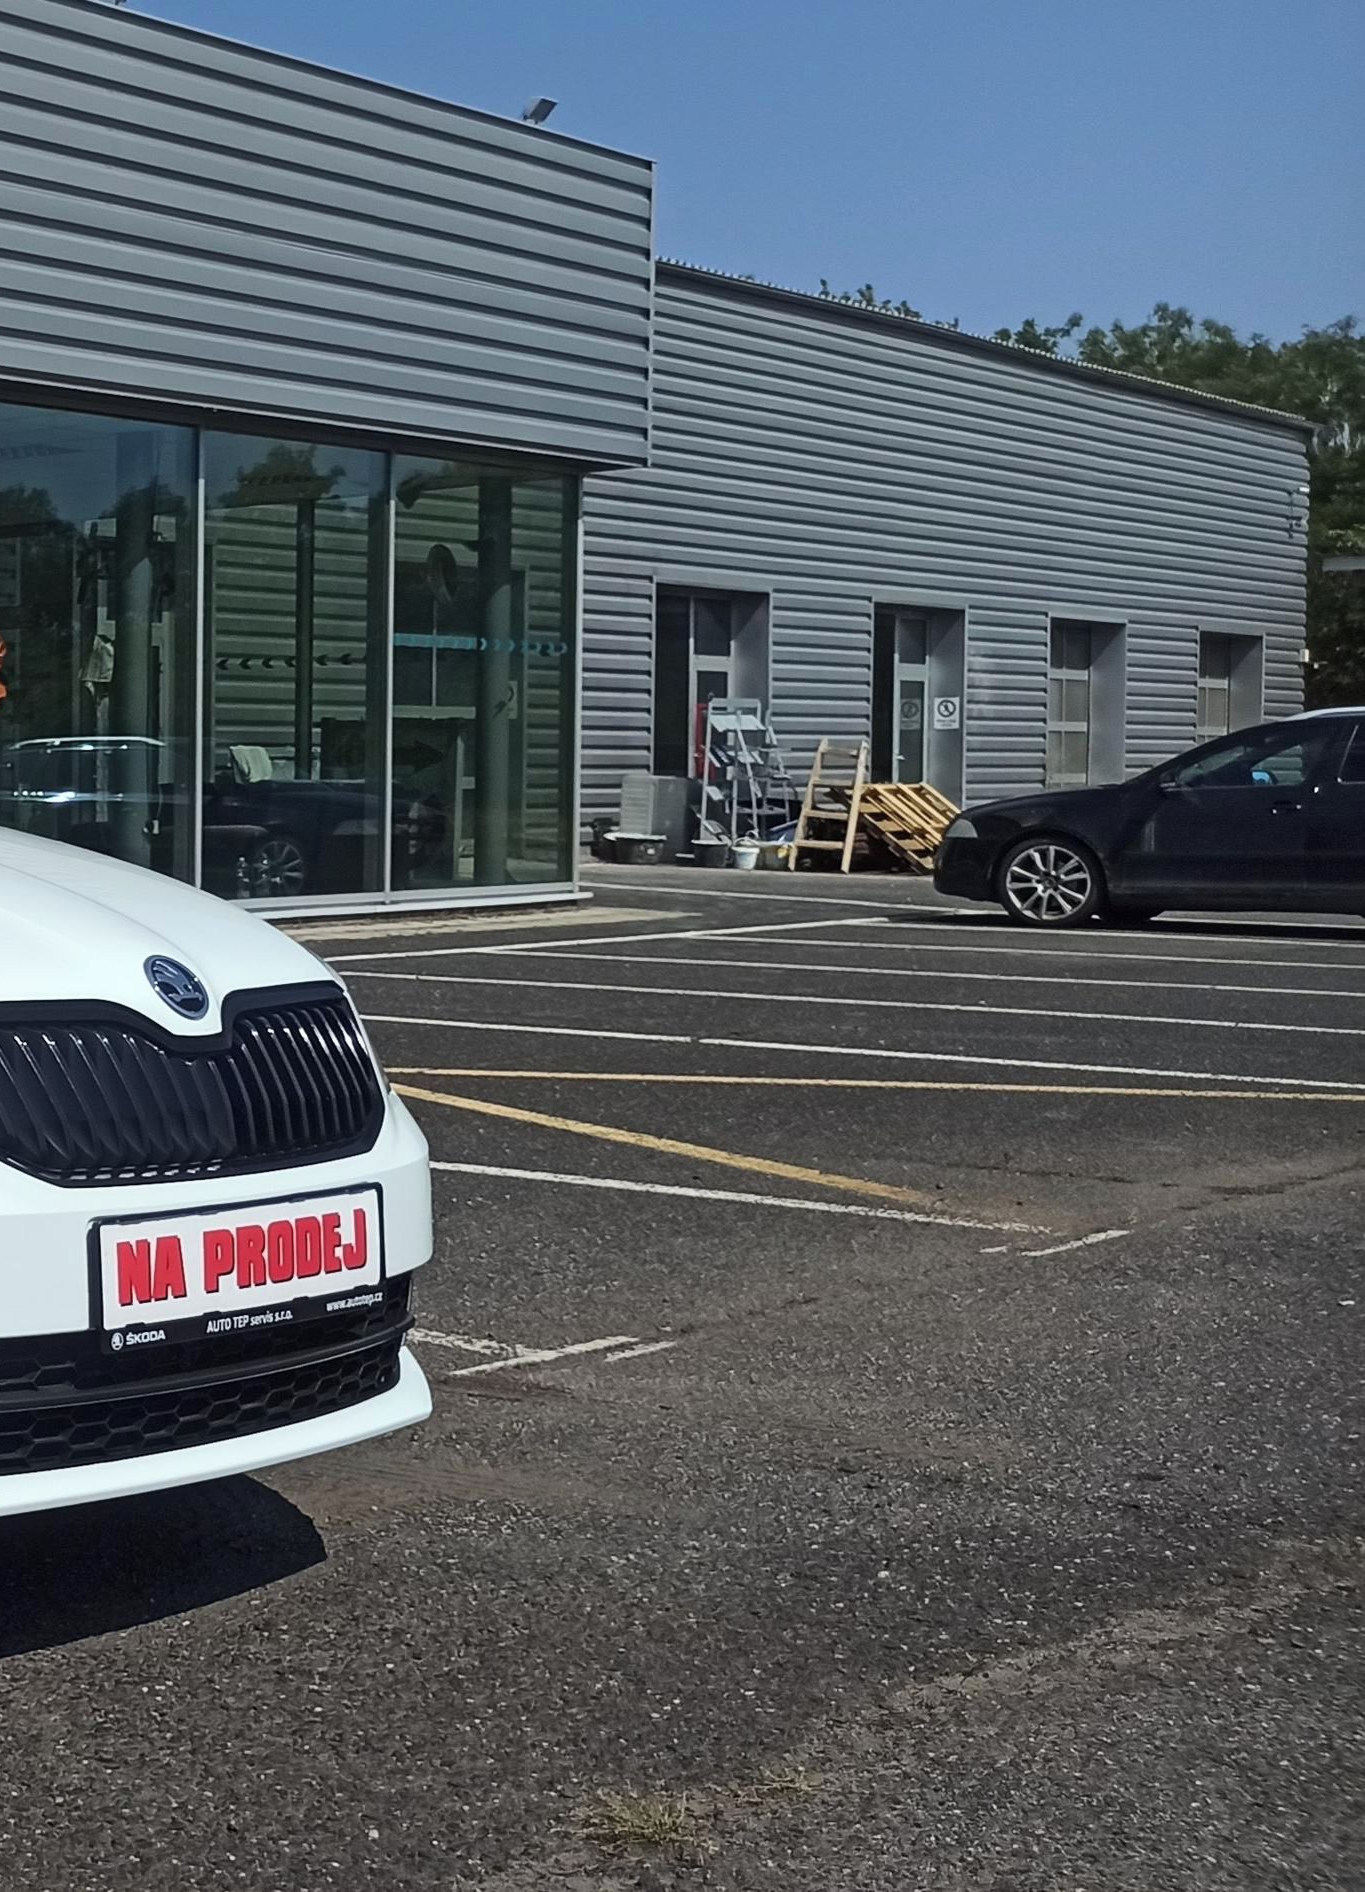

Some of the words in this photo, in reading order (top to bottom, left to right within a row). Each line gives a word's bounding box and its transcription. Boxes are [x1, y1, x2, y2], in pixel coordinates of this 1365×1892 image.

[117, 1236, 187, 1306] NA
[203, 1209, 367, 1293] PRODEJ
[206, 1317, 232, 1333] AUTO
[232, 1314, 249, 1329] TEP
[250, 1310, 274, 1326] servis
[274, 1310, 293, 1322] s.r.o.
[125, 1329, 166, 1346] ŠKODA
